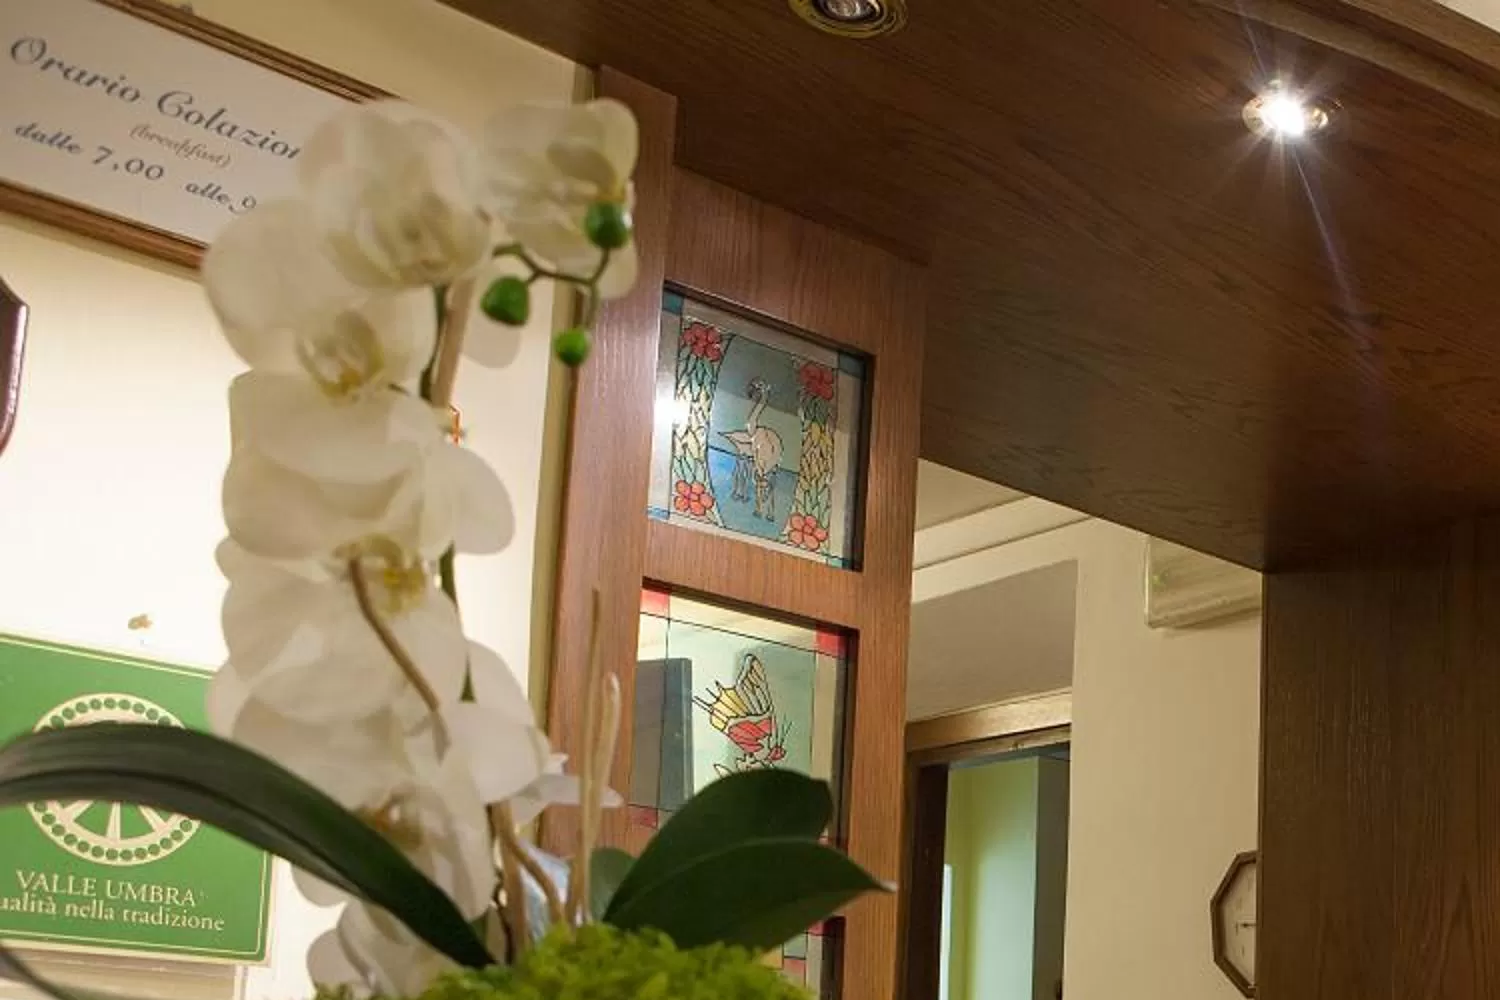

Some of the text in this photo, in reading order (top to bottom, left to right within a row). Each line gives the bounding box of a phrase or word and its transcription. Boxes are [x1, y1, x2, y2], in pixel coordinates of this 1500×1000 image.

[10, 36, 141, 104] Orario
[15, 122, 83, 154] dalle
[16, 870, 196, 907] VALLE UMBRA
[65, 898, 114, 920] nella
[123, 905, 225, 931] tradizione
